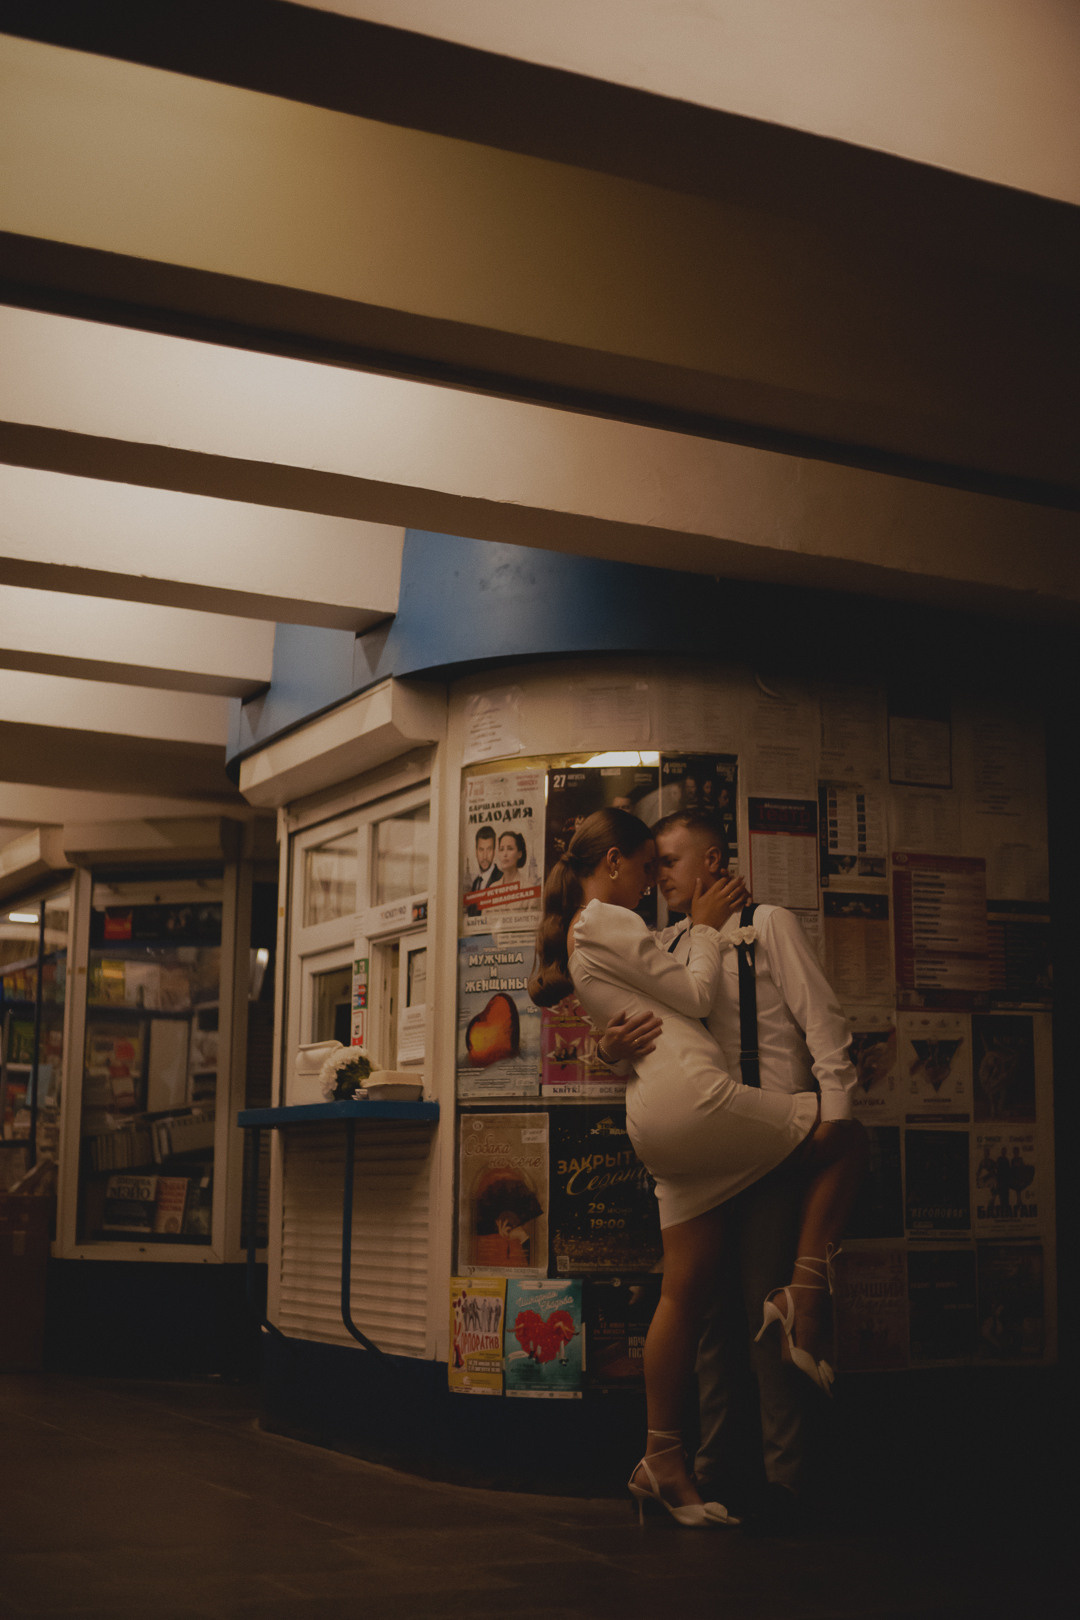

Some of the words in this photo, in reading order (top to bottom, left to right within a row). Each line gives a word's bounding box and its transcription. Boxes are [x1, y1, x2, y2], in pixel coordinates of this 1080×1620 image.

[553, 774, 567, 788] 27
[469, 799, 525, 812] ВАРШАВСКАЯ
[469, 807, 533, 824] МЕЛОДИЯ
[469, 952, 524, 967] МУЖЧИНА
[490, 967, 498, 979] И
[465, 978, 528, 993] ЖЕНЩИНЫ
[465, 1134, 511, 1156] Собака
[489, 1157, 506, 1168] на
[508, 1156, 544, 1169] сене
[557, 1151, 638, 1175] ЗАКРЫТ
[588, 1203, 606, 1214] 29
[977, 1205, 1038, 1218] БАЛАГАН
[591, 1219, 625, 1229] 19:00
